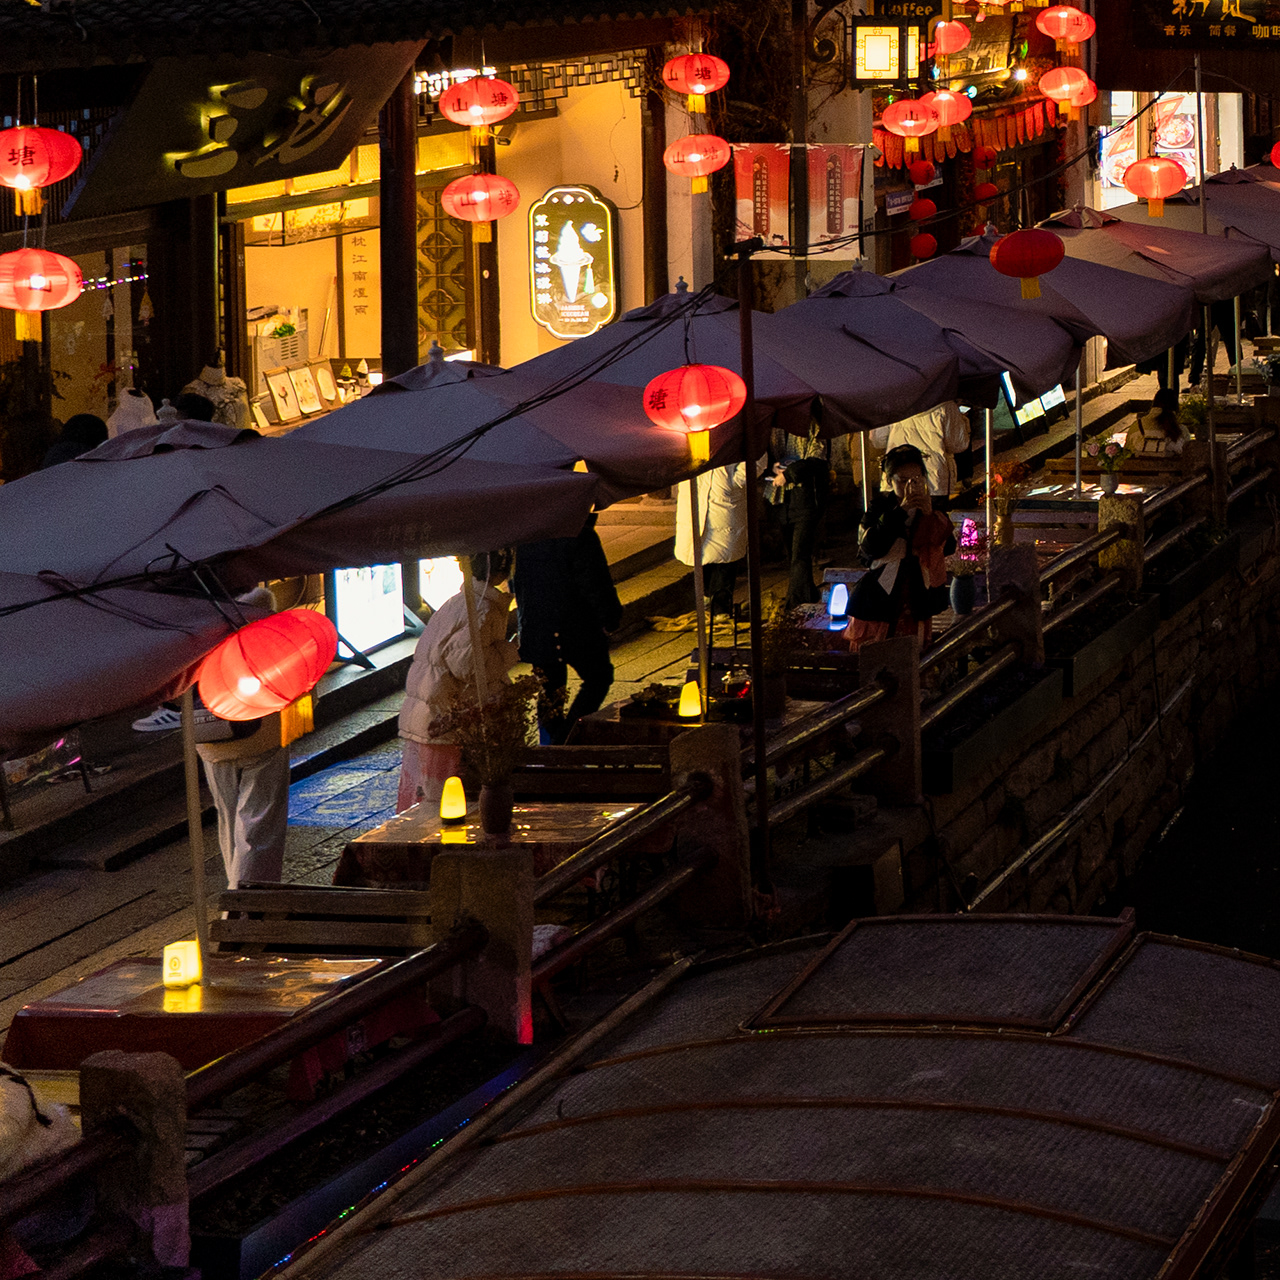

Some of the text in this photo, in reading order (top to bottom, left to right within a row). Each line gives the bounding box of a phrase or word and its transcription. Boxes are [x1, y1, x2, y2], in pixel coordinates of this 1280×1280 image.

[1163, 24, 1191, 37] 音乐
[1208, 24, 1237, 37] 简餐
[8, 145, 35, 167] 塘
